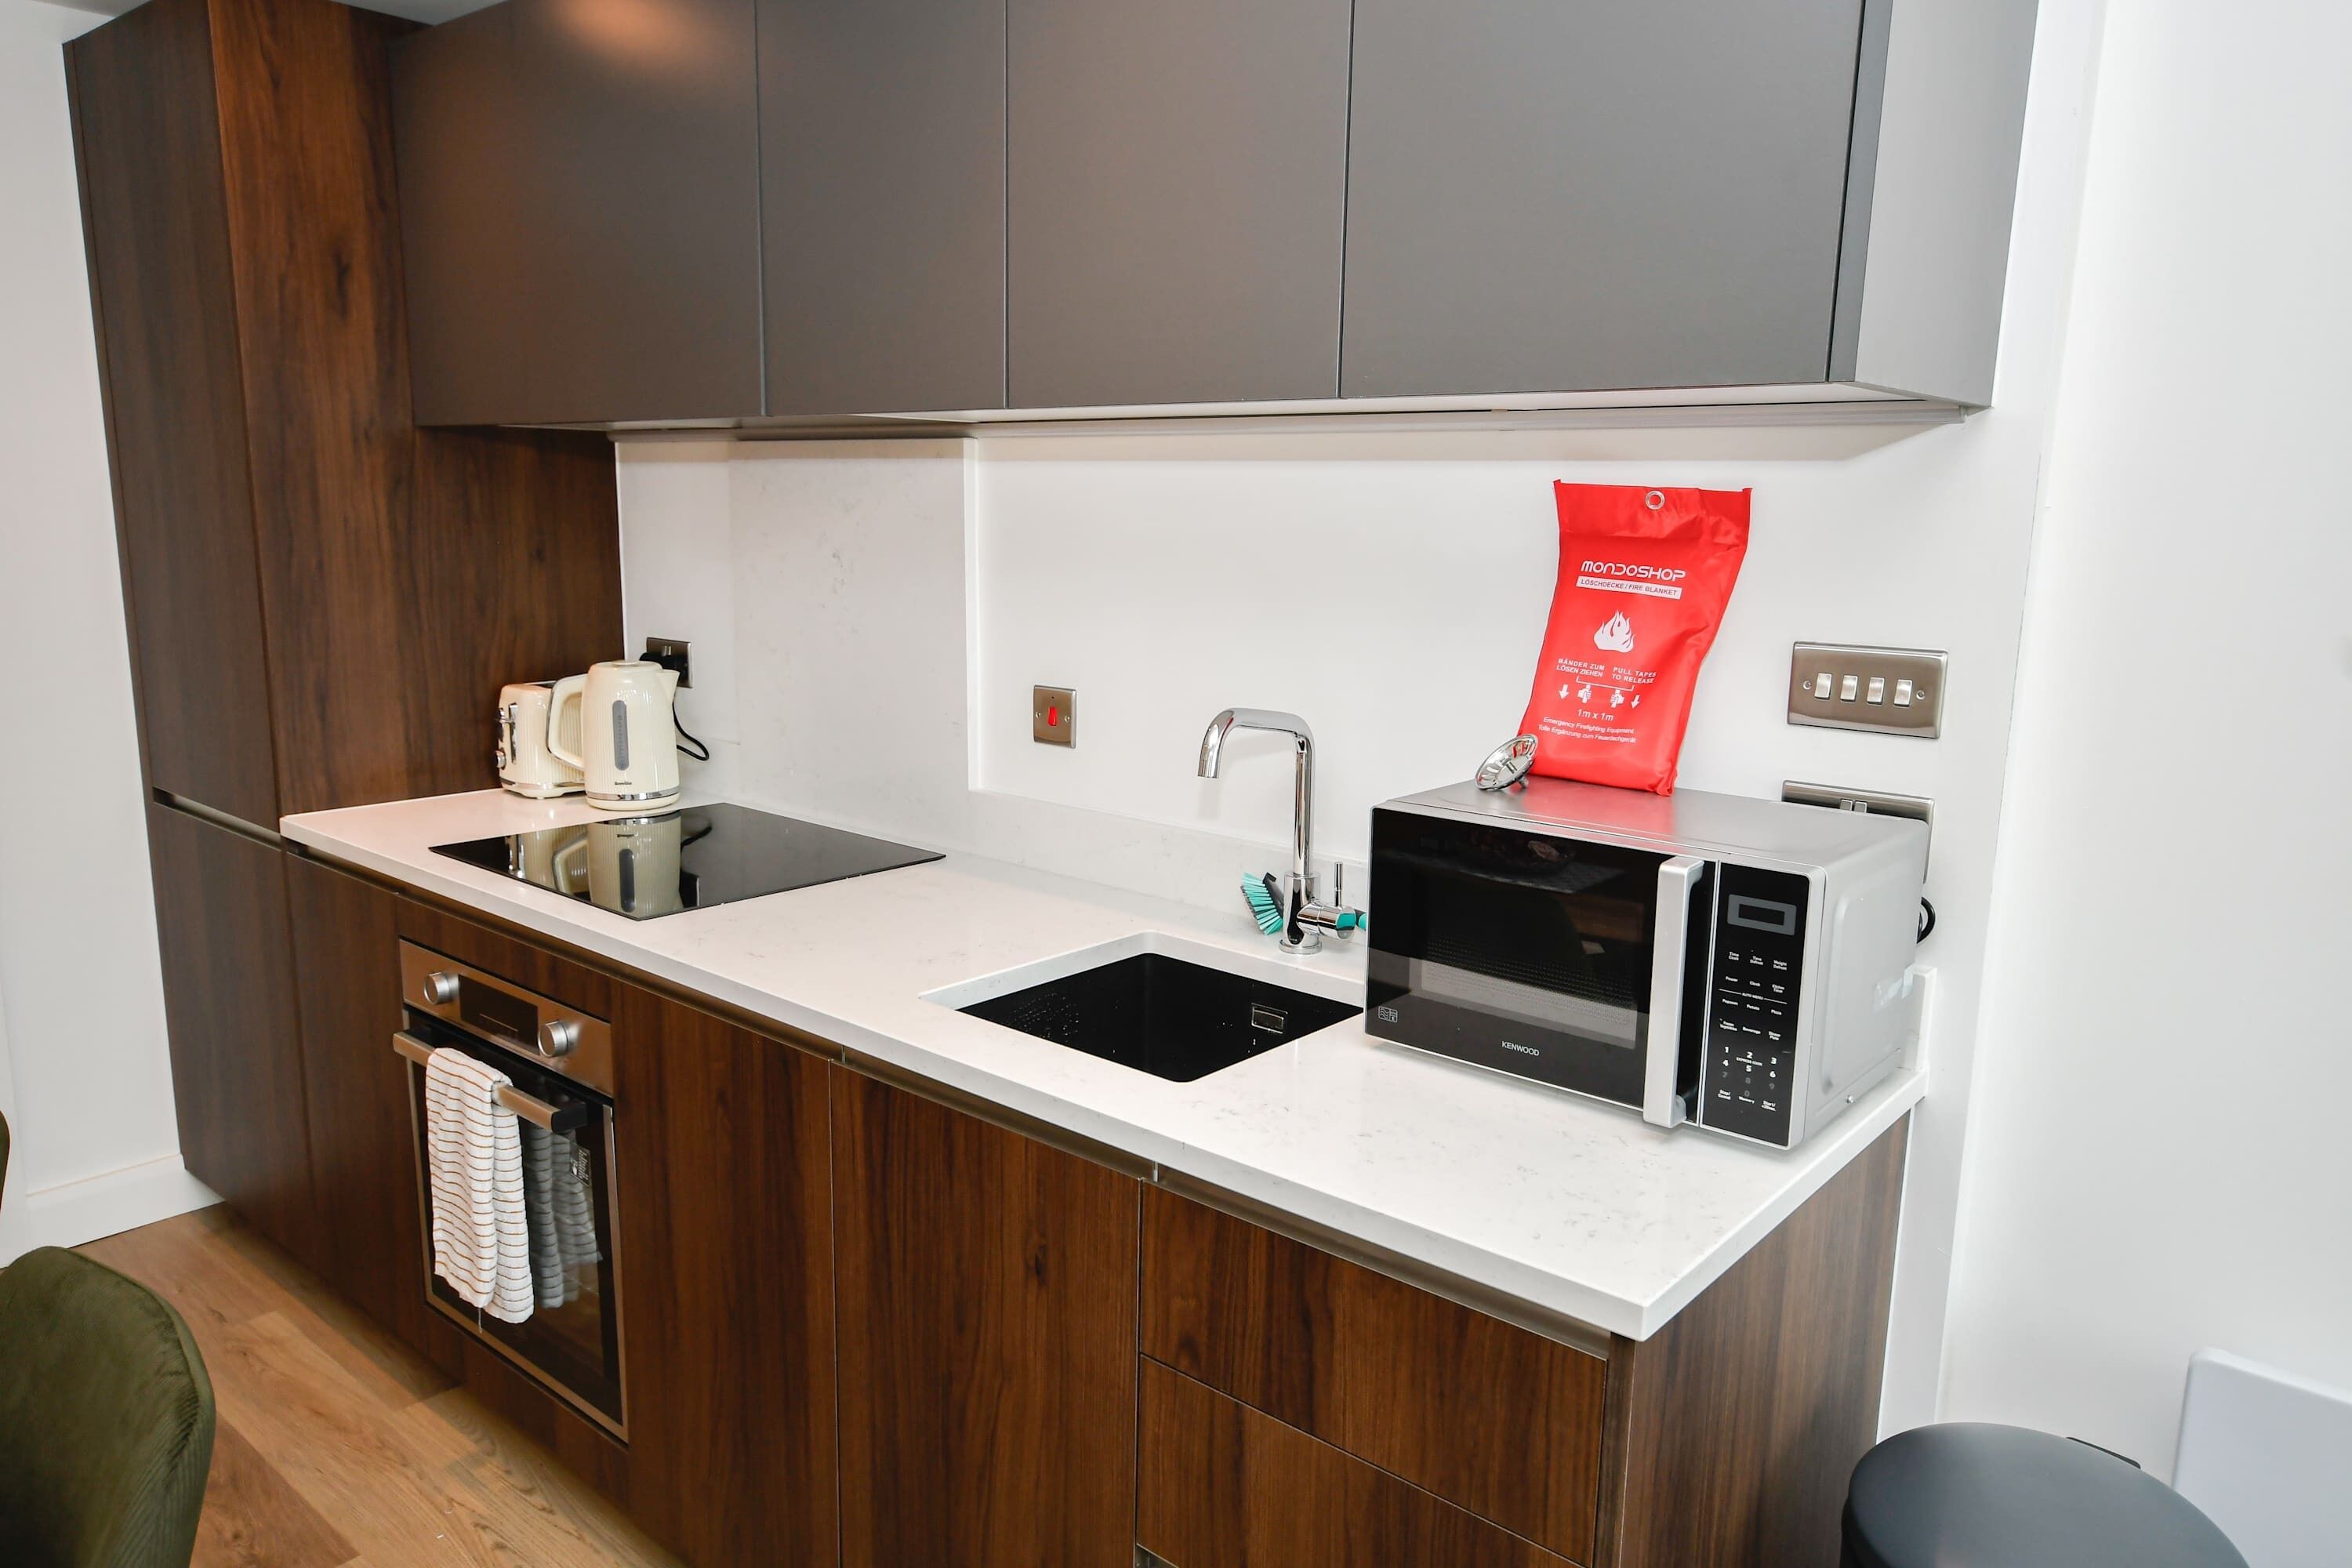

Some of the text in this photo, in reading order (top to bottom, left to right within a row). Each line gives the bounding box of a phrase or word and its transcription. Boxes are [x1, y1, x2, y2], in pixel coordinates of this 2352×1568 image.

[1581, 579, 1624, 589] LÖSCHDECKE
[1645, 586, 1677, 596] BLANKET
[1559, 659, 1588, 668] BÄNDER
[1623, 675, 1654, 684] RELEASE
[1601, 713, 1613, 721] 1m
[1543, 717, 1575, 728] Emergency
[1576, 723, 1606, 733] Firefighting
[1501, 1040, 1540, 1056] KENWOOD
